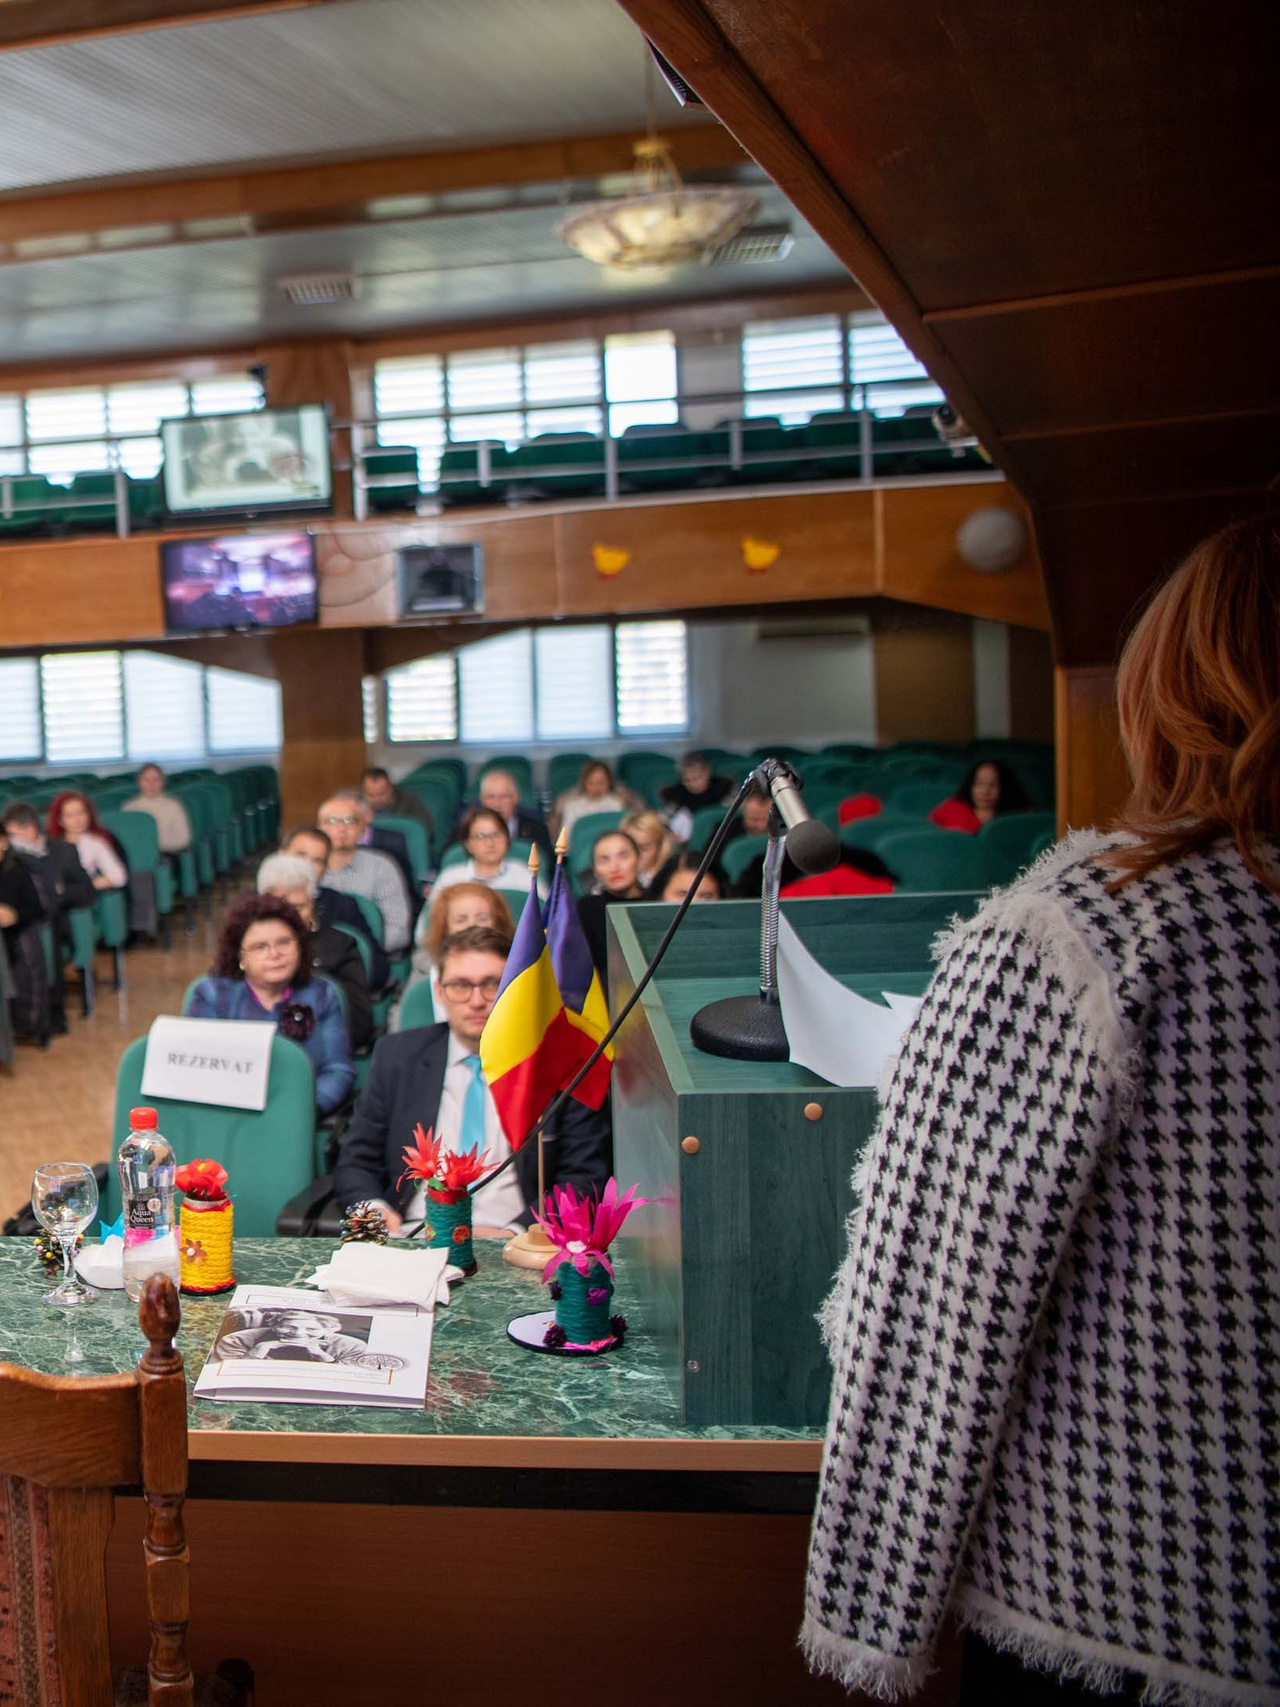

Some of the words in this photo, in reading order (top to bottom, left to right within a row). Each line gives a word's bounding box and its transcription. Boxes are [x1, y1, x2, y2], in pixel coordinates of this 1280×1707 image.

[167, 1052, 254, 1074] REZERVAT
[131, 1208, 152, 1217] Aqua
[130, 1214, 154, 1224] Queen
